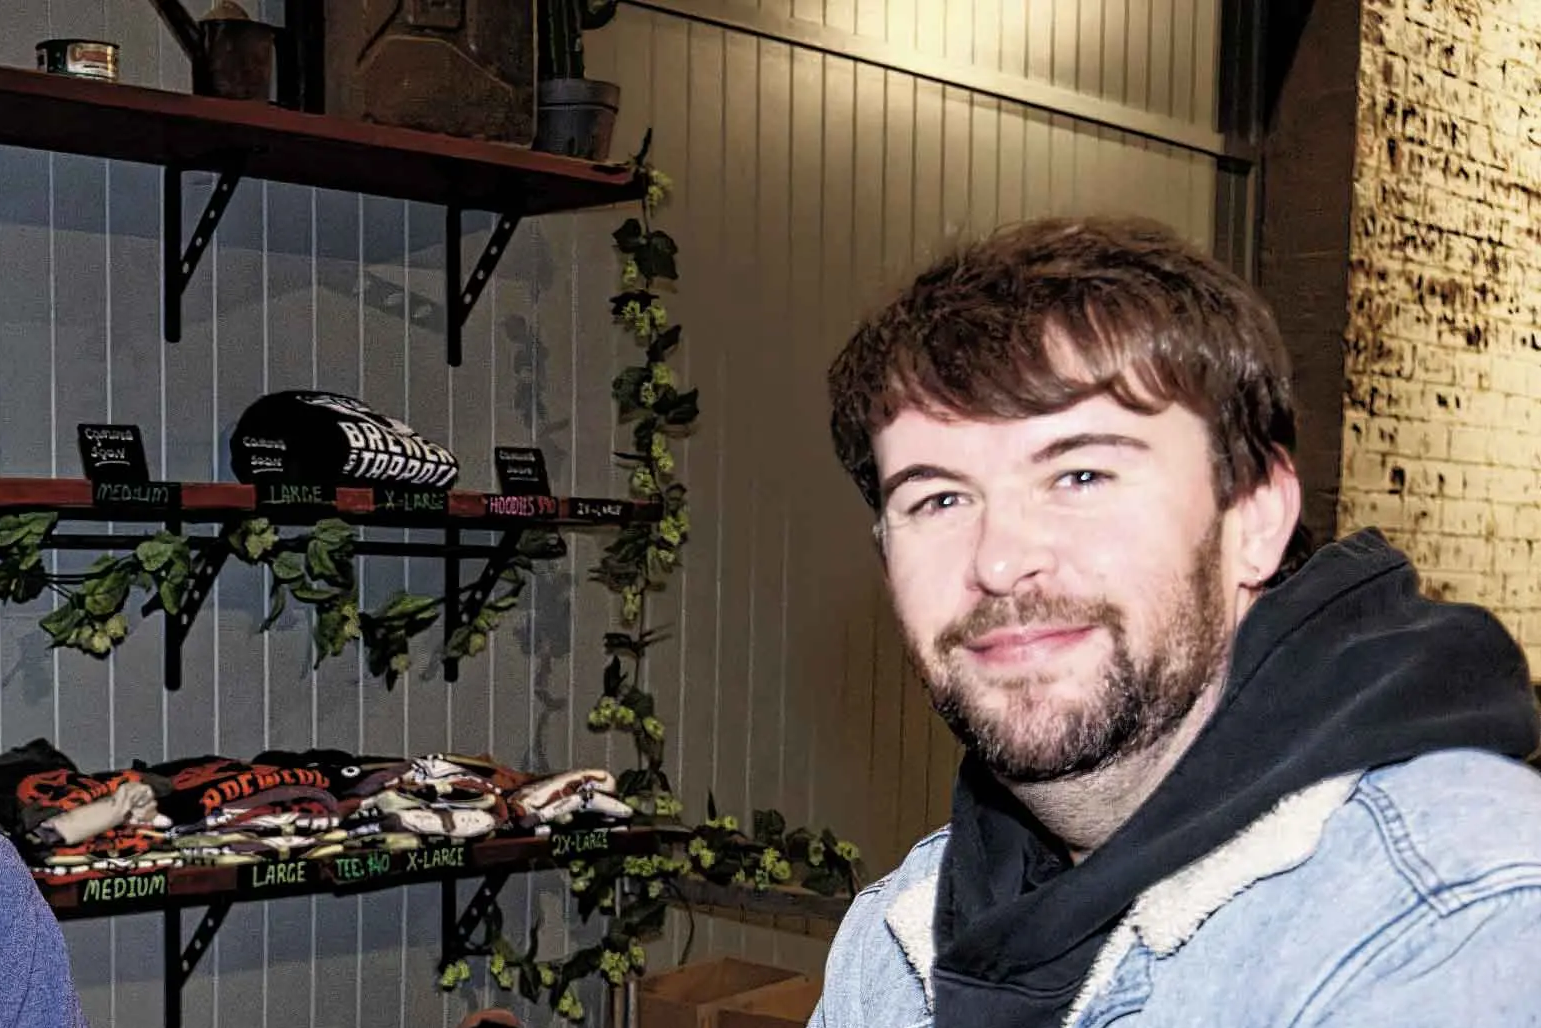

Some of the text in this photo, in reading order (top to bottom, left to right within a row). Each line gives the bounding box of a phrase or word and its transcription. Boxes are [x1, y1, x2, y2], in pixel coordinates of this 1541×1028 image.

[553, 831, 610, 857] 2X-LARGE
[406, 847, 465, 873] X-LARGE
[83, 873, 167, 902] MEDIUM
[252, 861, 307, 889] LARGE
